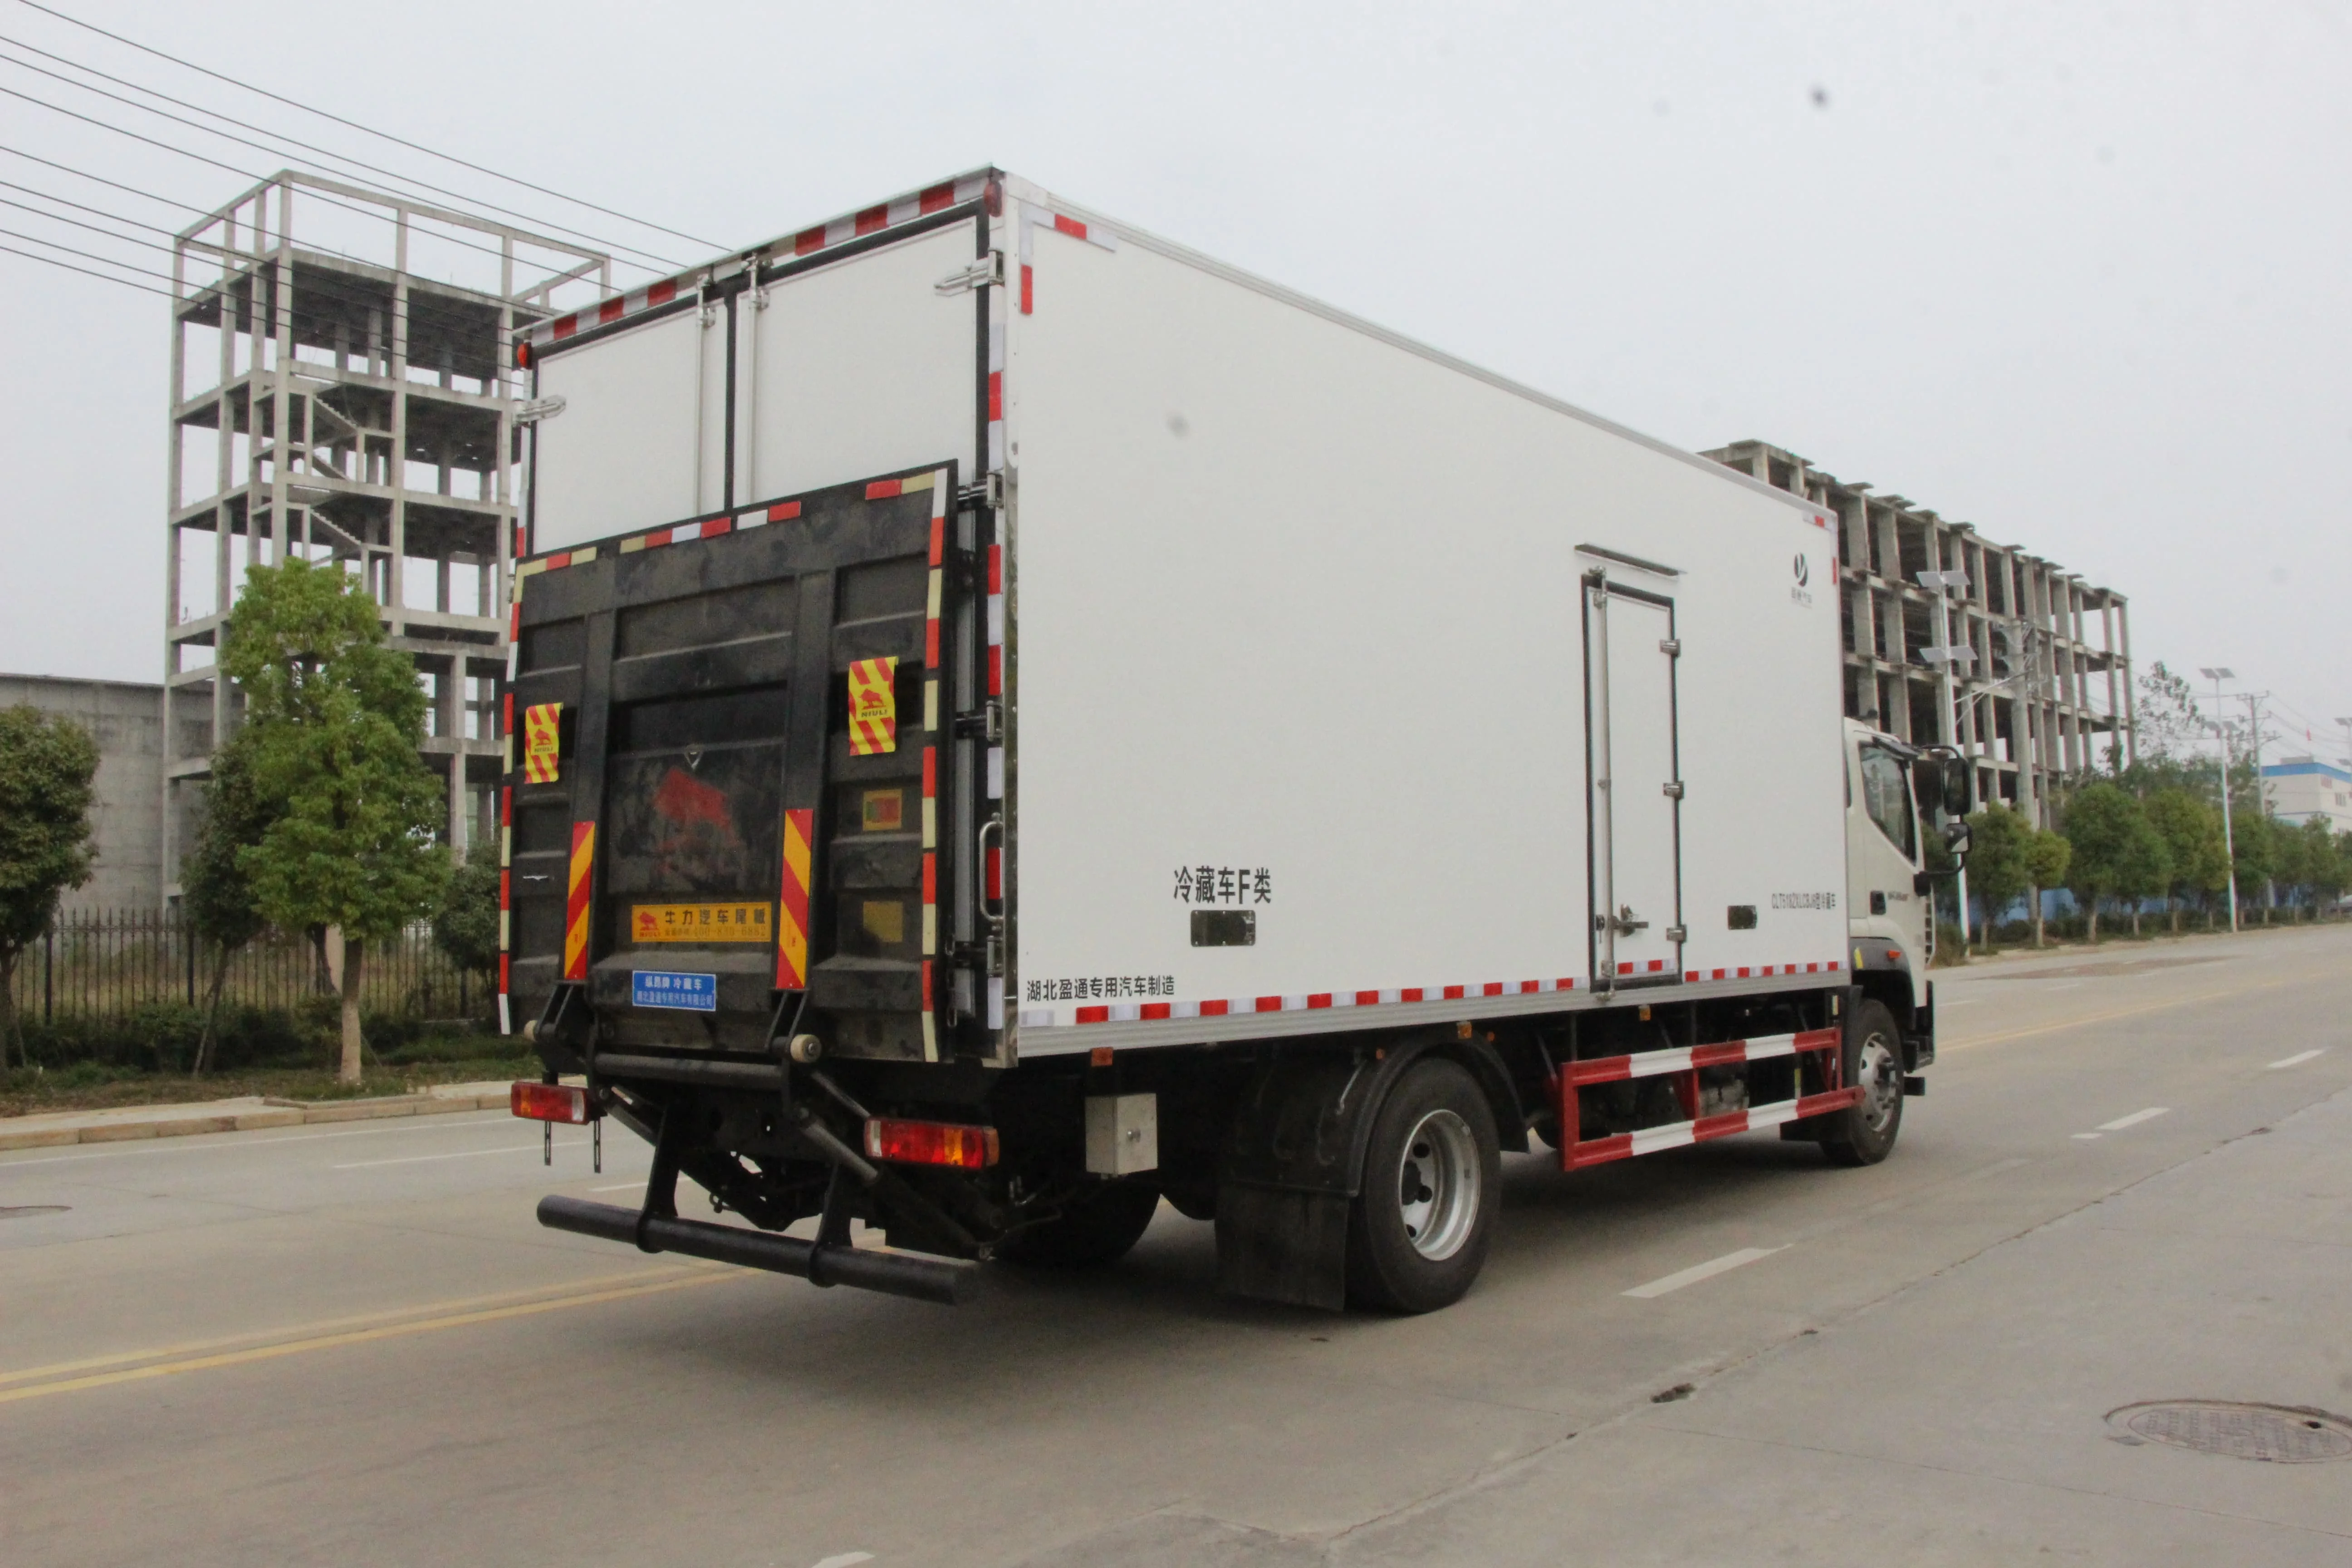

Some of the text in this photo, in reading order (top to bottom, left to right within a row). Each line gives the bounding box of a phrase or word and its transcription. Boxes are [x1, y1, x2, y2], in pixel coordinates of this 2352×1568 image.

[1173, 865, 1272, 904] 冷藏车F类
[1027, 975, 1175, 1002] 湖北盈通专用汽车制造
